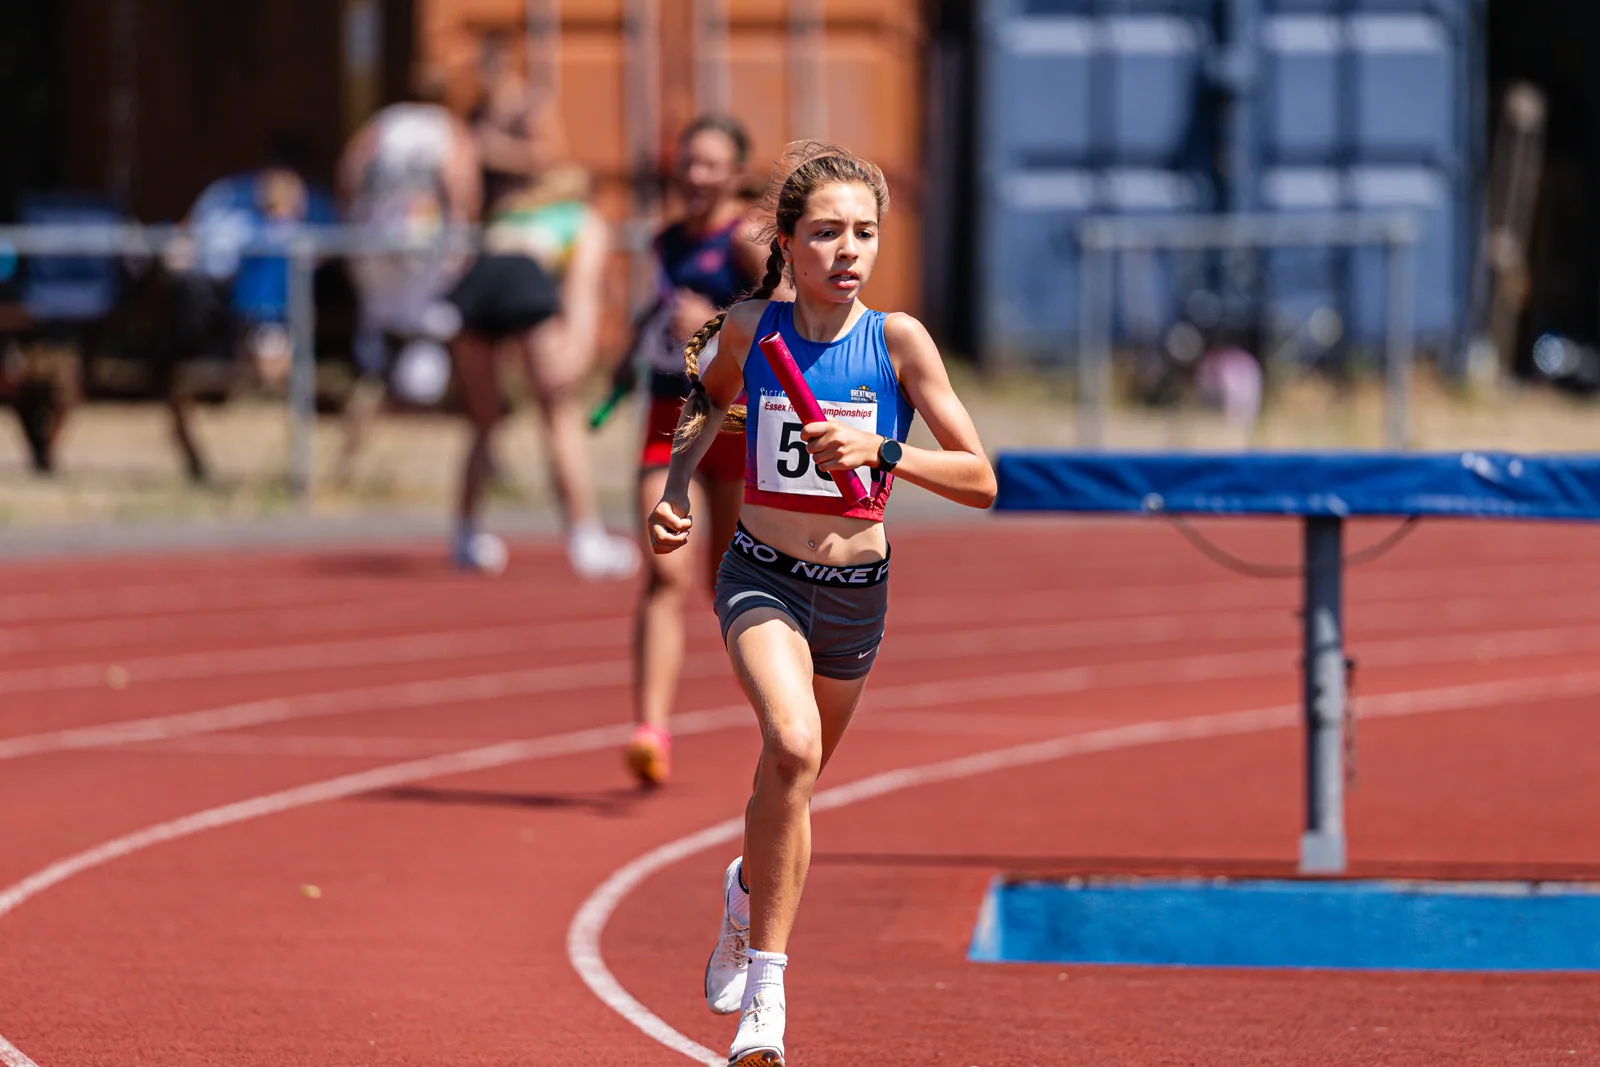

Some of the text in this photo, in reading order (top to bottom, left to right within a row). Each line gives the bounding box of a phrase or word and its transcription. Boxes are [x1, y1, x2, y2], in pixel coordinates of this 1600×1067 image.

[764, 401, 787, 412] Essex
[822, 407, 872, 419] ampionships
[790, 560, 874, 584] NIKE
